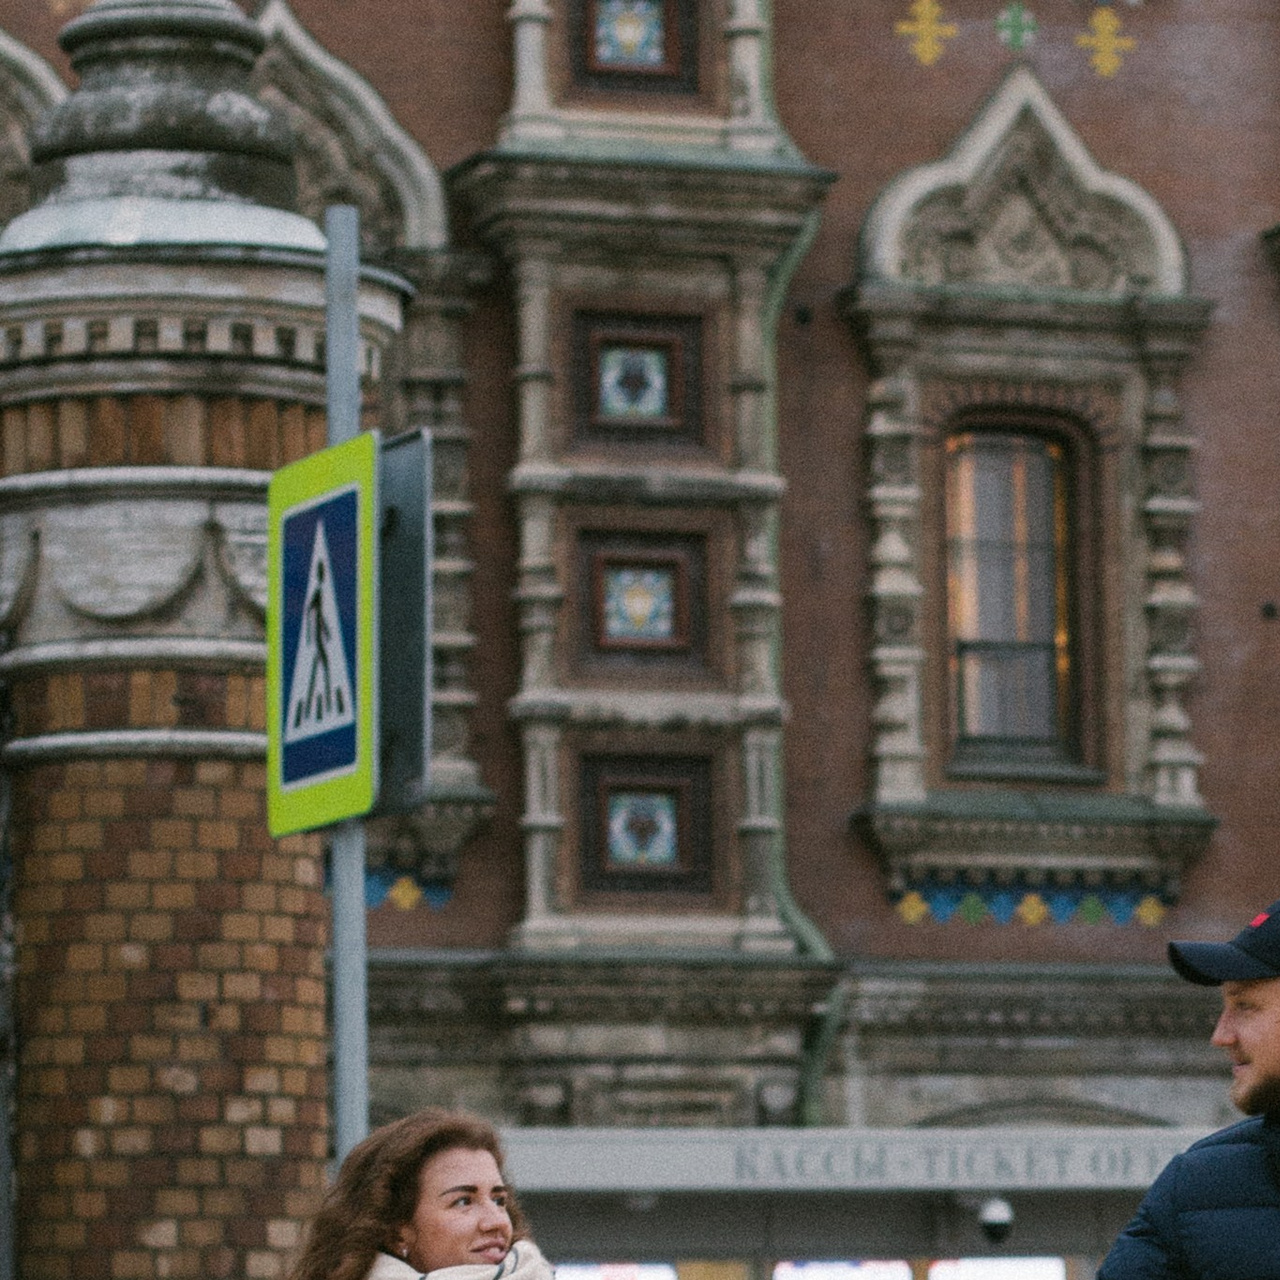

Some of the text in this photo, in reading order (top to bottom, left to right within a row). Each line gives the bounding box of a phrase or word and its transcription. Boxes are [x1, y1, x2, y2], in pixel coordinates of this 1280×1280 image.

[733, 1144, 887, 1178] КАССЫ
[922, 1145, 1172, 1179] TICKET OFF
